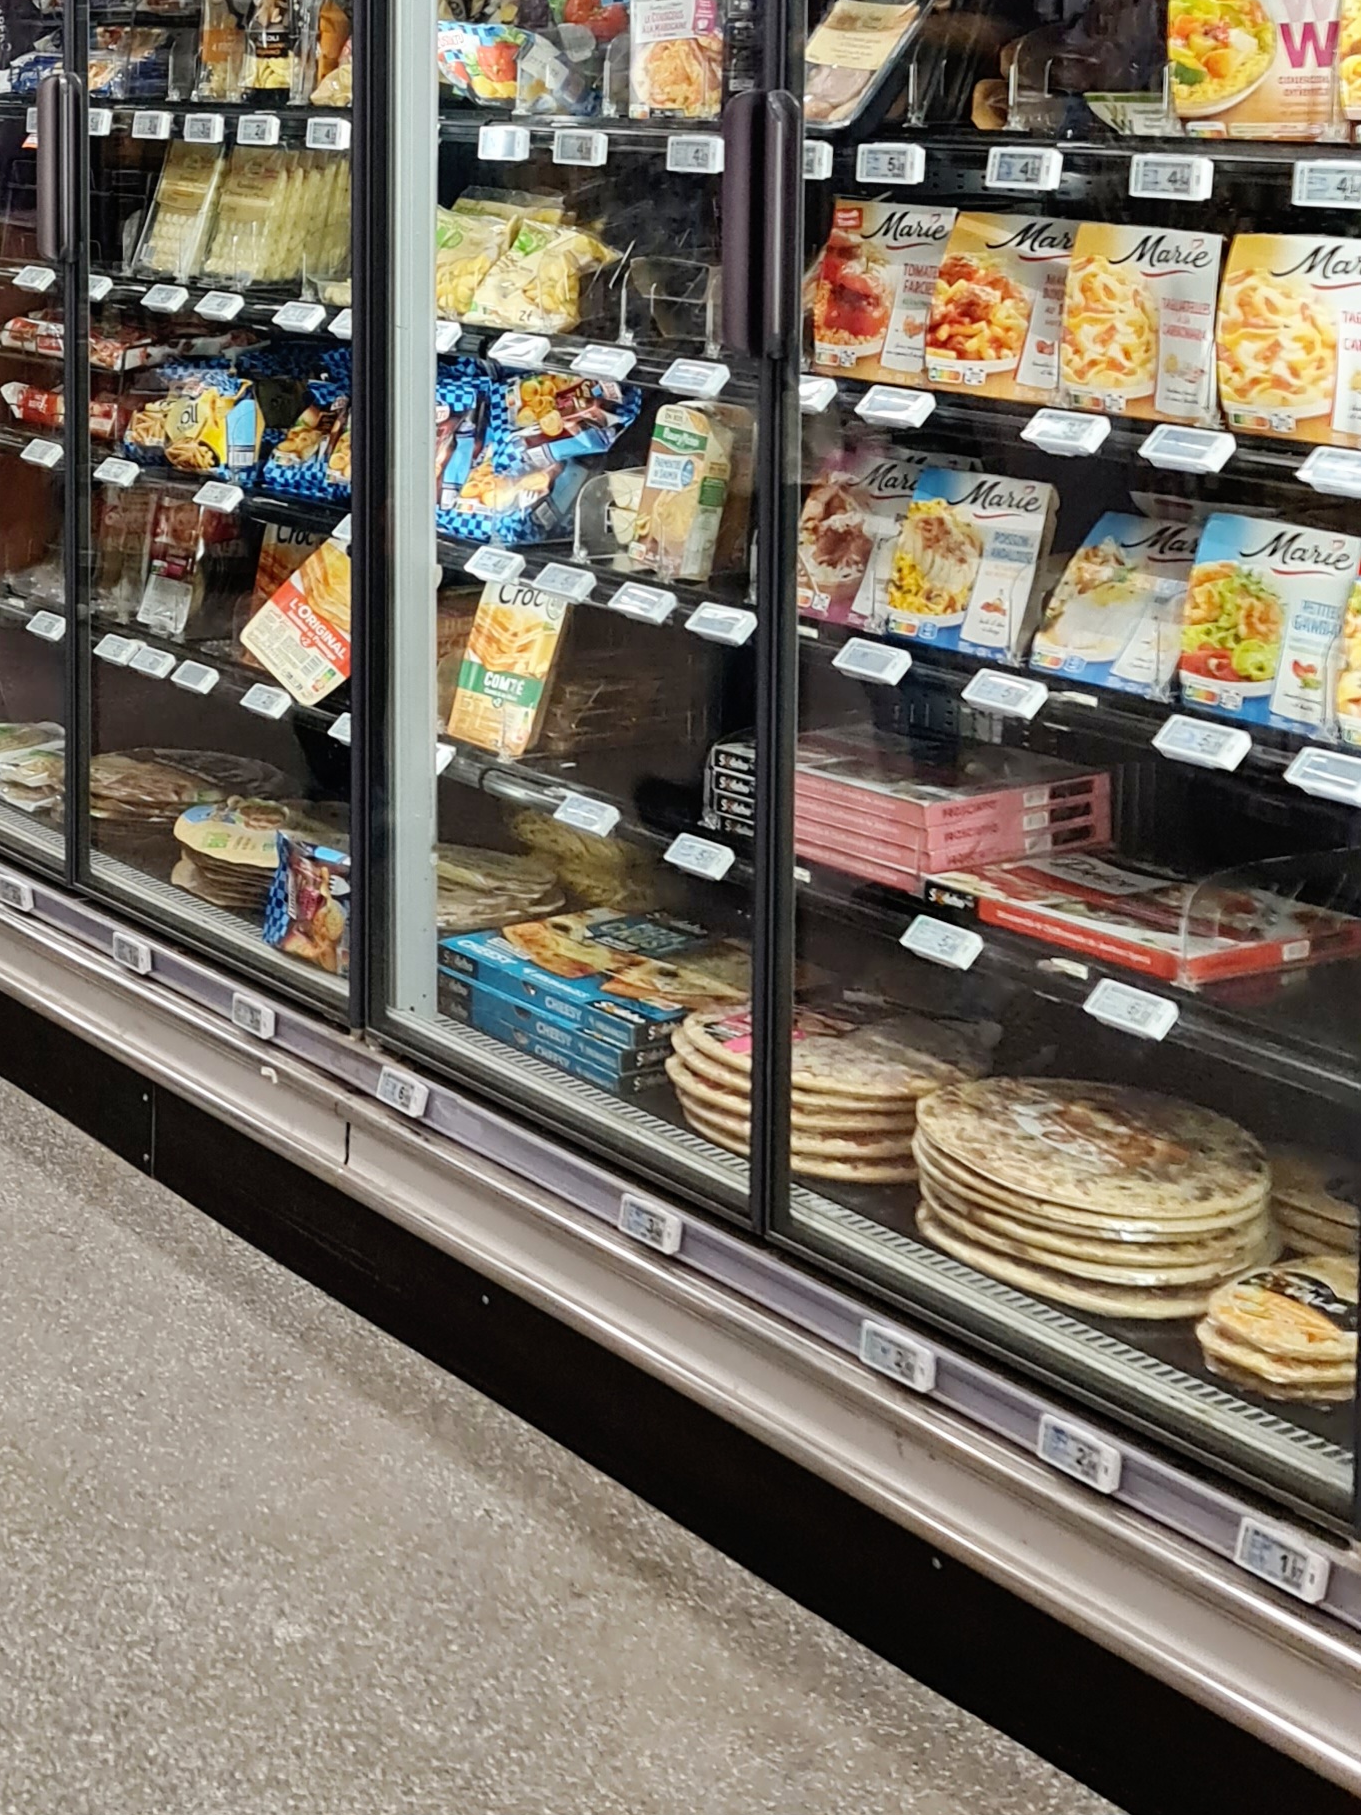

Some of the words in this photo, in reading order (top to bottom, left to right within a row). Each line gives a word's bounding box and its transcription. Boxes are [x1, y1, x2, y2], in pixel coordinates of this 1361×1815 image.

[1278, 20, 1341, 68] W
[860, 210, 951, 241] Marie
[985, 222, 1075, 252] Mar
[1108, 235, 1214, 269] Marie
[1269, 244, 1361, 279] Mar
[842, 463, 918, 491] Mari
[946, 480, 1043, 513] Marie
[1120, 525, 1198, 555] Mar
[1239, 530, 1355, 571] Marie
[498, 584, 544, 607] Croc
[289, 597, 348, 661] L'ORIGINAL
[483, 671, 526, 694] COMTÉ
[456, 939, 519, 965] CHEESY
[544, 996, 582, 1021] CHEESY
[535, 1021, 573, 1047] CHEESY
